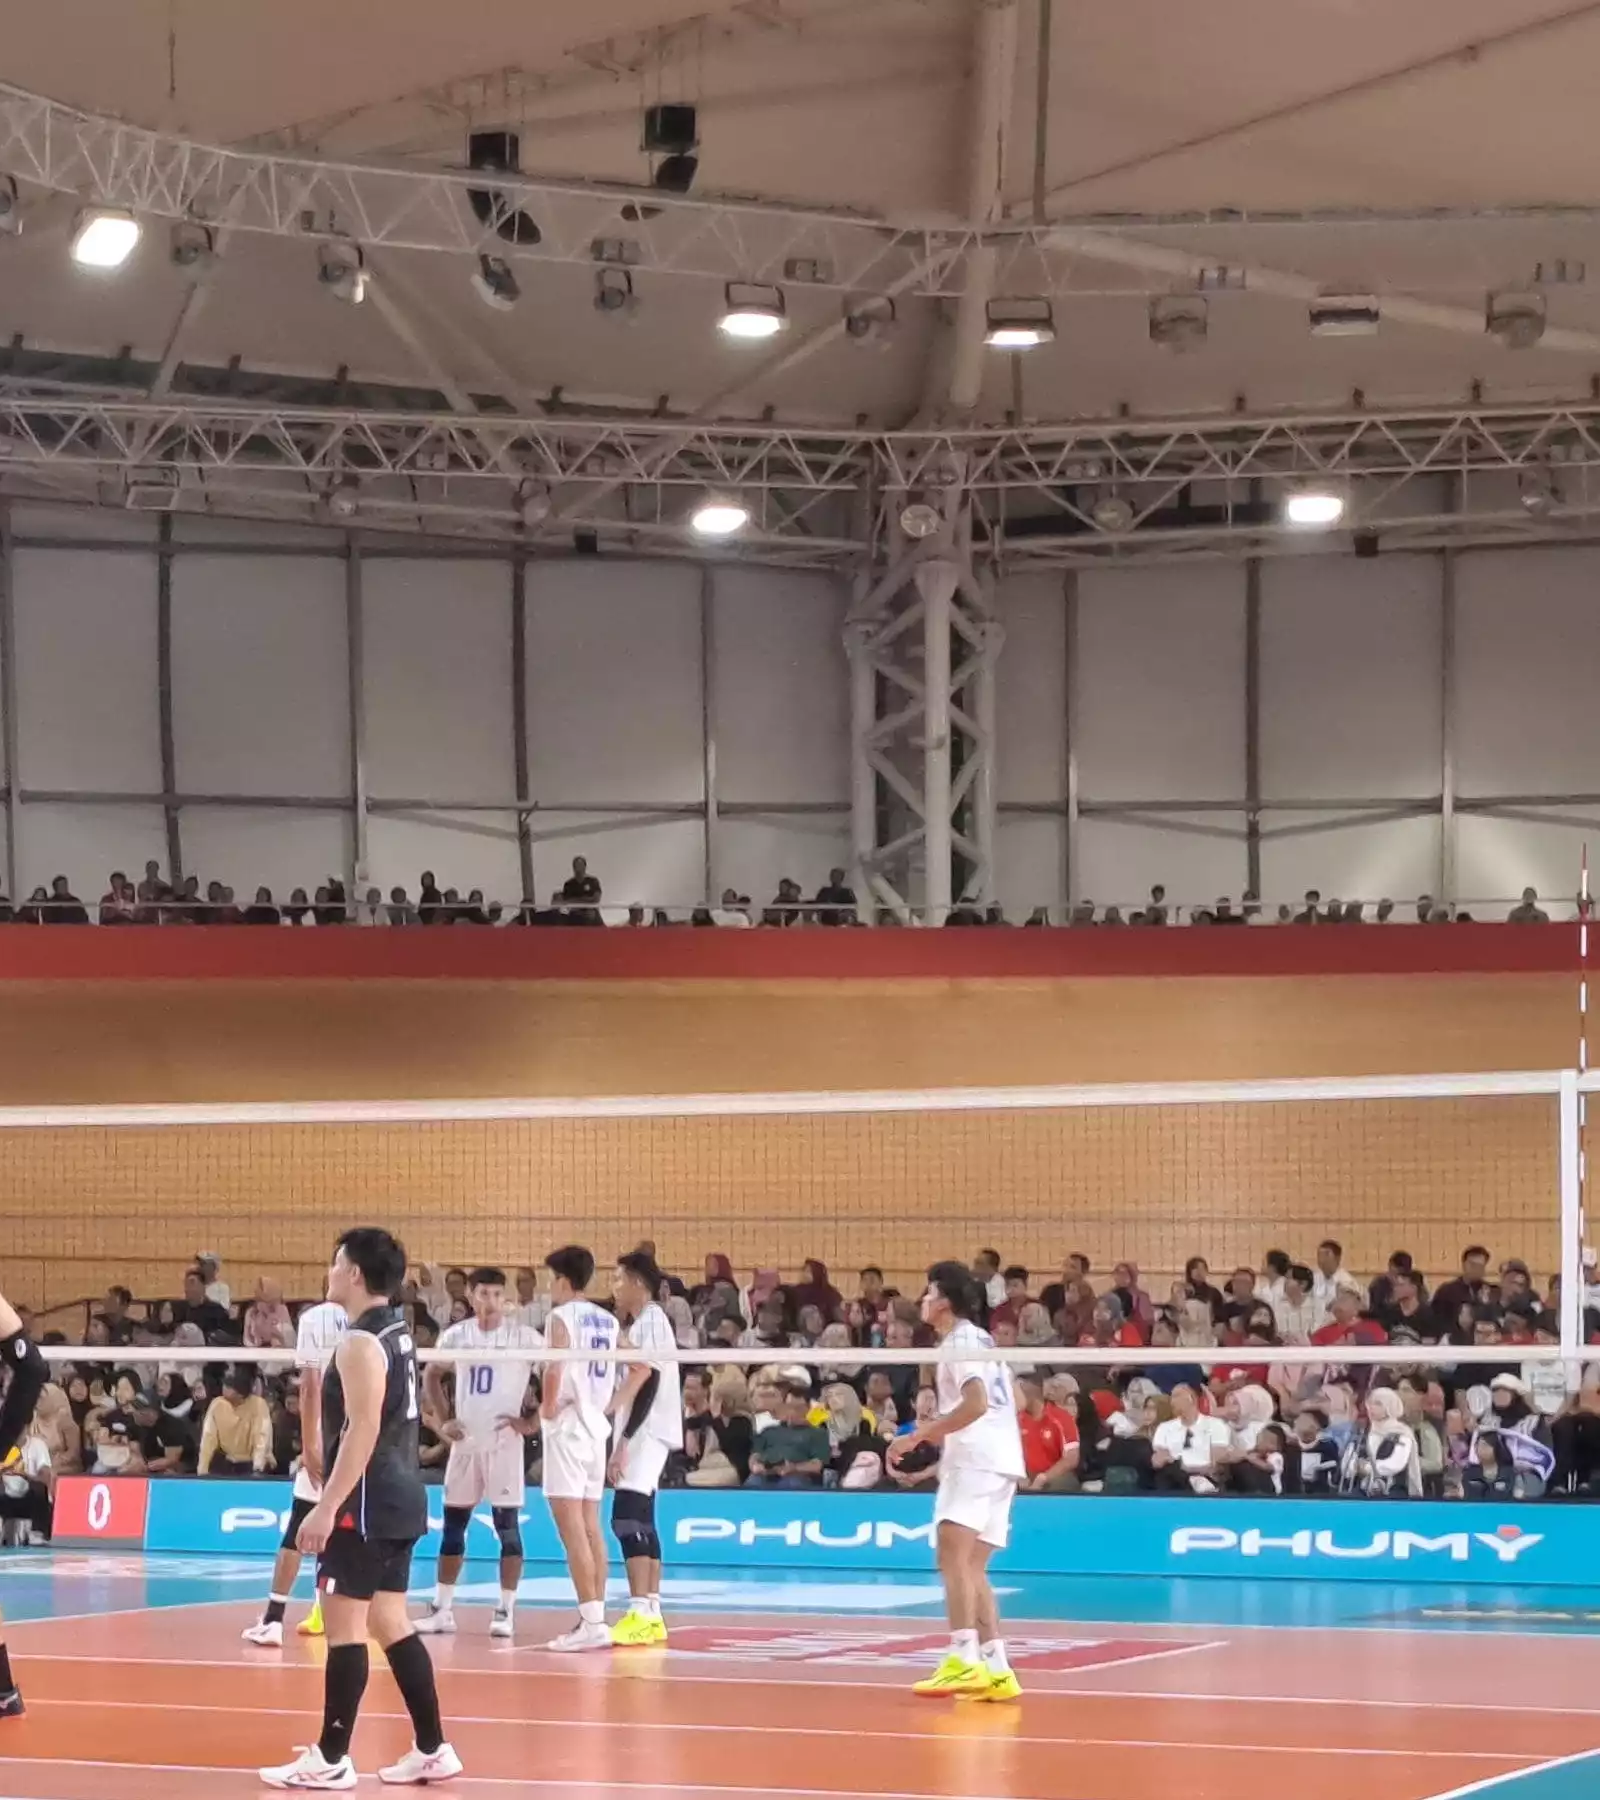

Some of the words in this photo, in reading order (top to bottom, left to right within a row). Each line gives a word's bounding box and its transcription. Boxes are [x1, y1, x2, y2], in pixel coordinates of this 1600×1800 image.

[469, 1364, 493, 1395] 10
[87, 1484, 111, 1530] 0
[676, 1518, 1012, 1549] PHUM
[1170, 1526, 1545, 1562] PHUMY
